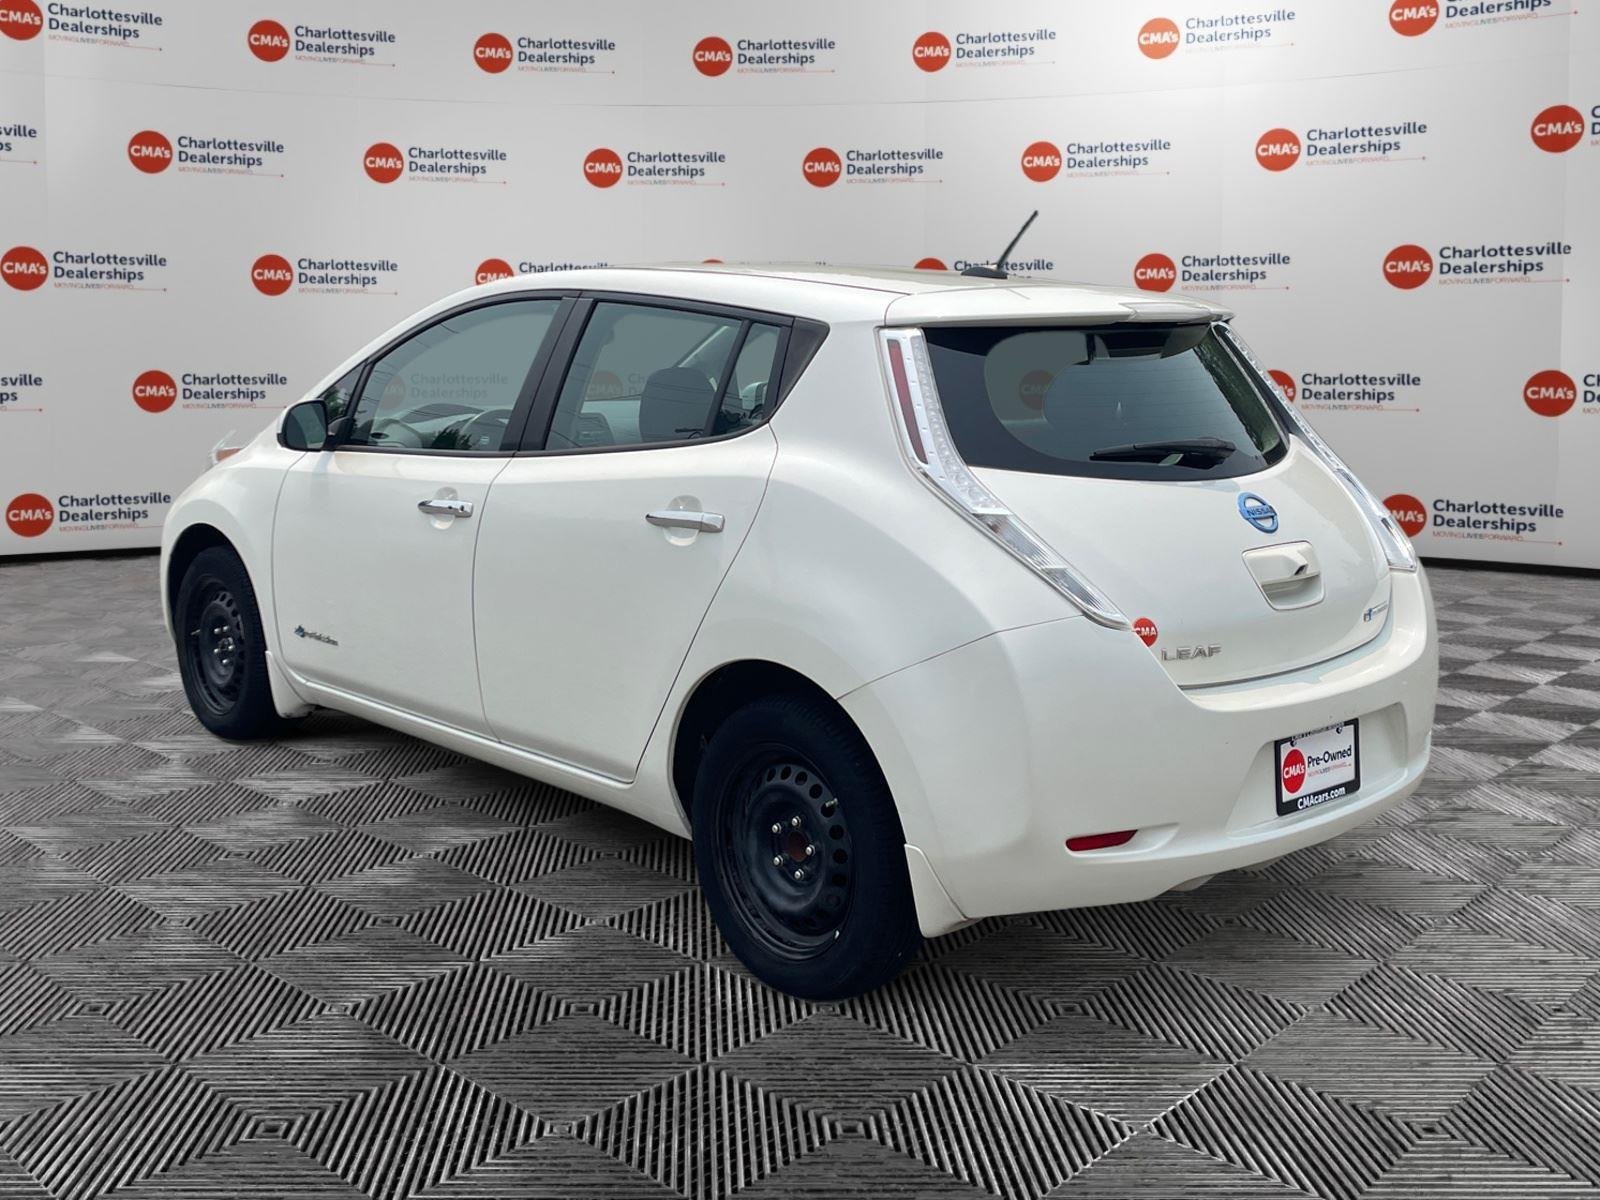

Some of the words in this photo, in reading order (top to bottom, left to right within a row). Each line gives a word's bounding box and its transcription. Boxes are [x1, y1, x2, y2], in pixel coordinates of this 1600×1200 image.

[0, 10, 41, 26] CMA's
[48, 3, 163, 26] Charlottesville
[1185, 10, 1296, 29] Charlottesville
[1391, 6, 1437, 21] CMA's
[48, 18, 139, 39] Dealerships
[295, 26, 396, 43] Charlottesville
[1186, 27, 1271, 44] Dealerships
[250, 34, 288, 48] CMA's
[518, 37, 615, 51] Charlottesville
[737, 38, 836, 51] Charlottesville
[956, 29, 1056, 46] Charlottesville
[1139, 31, 1179, 45] CMA's
[295, 41, 375, 57] Dealerships
[475, 47, 512, 59] CMA's
[914, 46, 950, 58] CMA's
[956, 44, 1035, 59] Dealerships
[518, 51, 595, 66] Dealerships
[695, 51, 730, 62] CMA's
[737, 52, 815, 66] Dealerships
[1307, 122, 1427, 141] Charlottesville
[1533, 121, 1582, 136] CMA's
[130, 145, 171, 158] CMA's
[178, 136, 284, 153] Charlottesville
[1067, 139, 1171, 154] Charlottesville
[1257, 143, 1299, 157] CMA's
[1307, 140, 1401, 156] Dealerships
[178, 151, 263, 168] Dealerships
[408, 147, 506, 161] Charlottesville
[627, 151, 725, 164] Charlottesville
[846, 149, 944, 162] Charlottesville
[1023, 155, 1061, 167] CMA's
[1067, 153, 1149, 169] Dealerships
[366, 156, 402, 169] CMA's
[408, 161, 487, 175] Dealerships
[585, 162, 621, 173] CMA's
[804, 161, 840, 173] CMA's
[846, 162, 924, 176] Dealerships
[627, 165, 705, 179] Dealerships
[1439, 242, 1572, 259] Charlottesville
[53, 251, 167, 268] Charlottesville
[298, 258, 398, 272] Charlottesville
[1181, 253, 1290, 267] Charlottesville
[1439, 258, 1544, 274] Dealerships
[2, 262, 47, 275] CMA's
[53, 265, 144, 283] Dealerships
[1136, 268, 1175, 280] CMA's
[1385, 261, 1431, 273] CMA's
[253, 268, 291, 281] CMA's
[298, 272, 377, 287] Dealerships
[1182, 268, 1267, 283] Dealerships
[182, 373, 287, 386] Charlottesville
[1301, 373, 1420, 387] Charlottesville
[135, 385, 175, 397] CMA's
[182, 388, 266, 401] Dealerships
[1301, 388, 1395, 403] Dealerships
[1526, 388, 1574, 400] CMA's
[58, 492, 171, 508] Charlottesville
[8, 509, 52, 521] CMA's
[59, 507, 149, 523] Dealerships
[1433, 499, 1564, 518] Charlottesville
[1392, 510, 1425, 523] MA's
[1433, 514, 1537, 534] Dealerships
[1161, 645, 1222, 661] LEAF
[1307, 745, 1352, 768] Pre-Owned
[1283, 764, 1305, 779] CMA's
[1297, 786, 1346, 810] CMAcars.com
